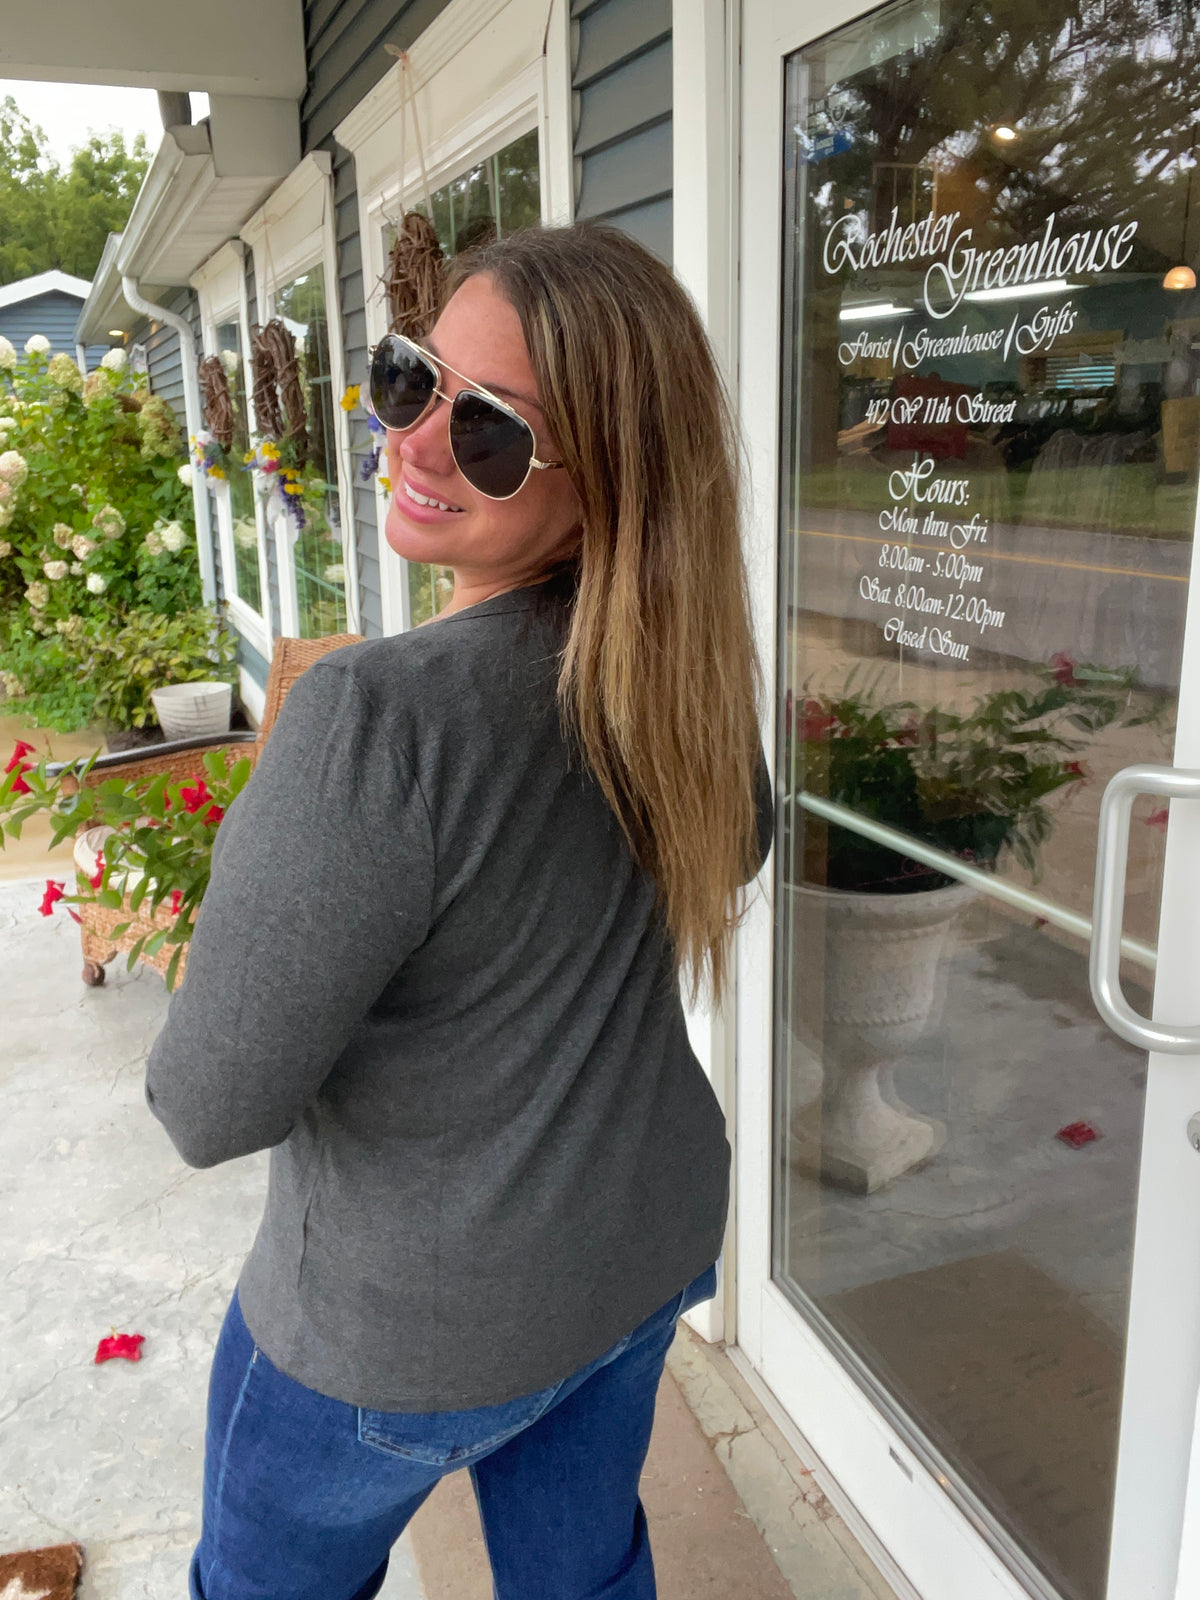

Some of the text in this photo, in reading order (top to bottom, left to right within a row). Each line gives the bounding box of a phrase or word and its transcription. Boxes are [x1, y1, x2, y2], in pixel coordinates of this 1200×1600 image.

[823, 205, 961, 274] Rochester
[924, 212, 1138, 318] Greenhouse
[1015, 301, 1077, 355] Gifts
[865, 399, 889, 425] 412
[922, 399, 952, 425] 11th
[955, 393, 1017, 424] Street
[888, 458, 970, 506] Hours:
[922, 510, 949, 538] thru
[883, 617, 928, 650] Closed
